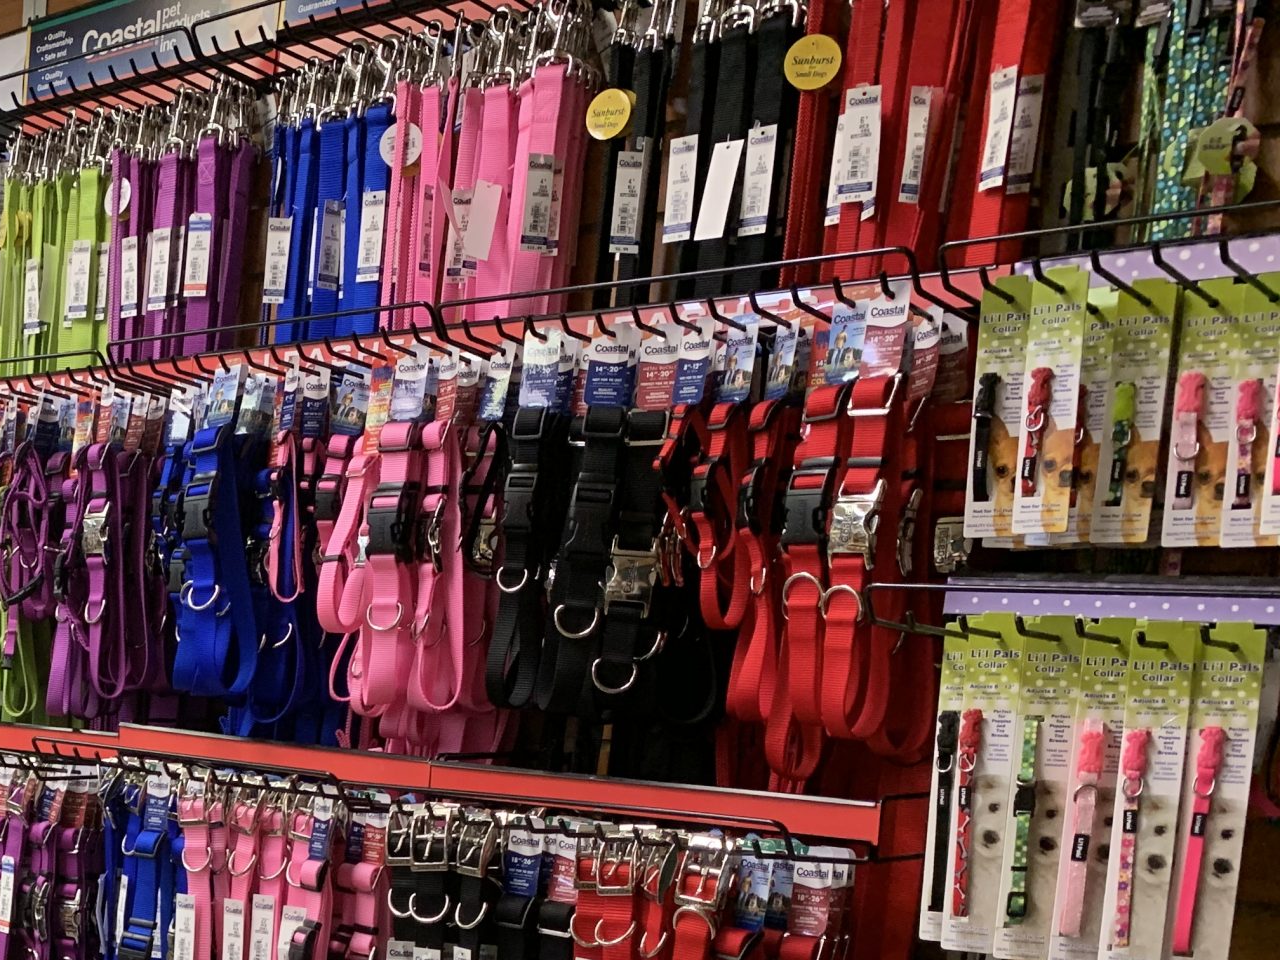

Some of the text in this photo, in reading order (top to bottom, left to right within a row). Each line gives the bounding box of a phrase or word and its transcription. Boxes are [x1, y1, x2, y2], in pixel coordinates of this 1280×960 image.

[48, 30, 66, 41] Quality
[81, 1, 182, 60] Coastal pet
[792, 55, 834, 66] Sunburst
[795, 69, 827, 80] Small Dogs
[849, 95, 879, 106] Coastal
[592, 107, 625, 117] Sunburst
[871, 304, 906, 317] Coastal
[1055, 302, 1082, 313] Pals
[834, 311, 866, 324] Coastal
[683, 340, 711, 351] Coastal
[727, 336, 753, 347] Coastal
[595, 343, 629, 353] Coastal
[645, 344, 679, 355] Coastal
[399, 363, 426, 372] Coastal
[490, 361, 512, 370] Coastal
[971, 650, 1020, 658] Li'l Pals
[1028, 653, 1080, 664] Li'l Pals
[1086, 658, 1105, 667] Li'l
[1133, 661, 1190, 671] Li'l Pals
[1203, 662, 1260, 672] Li'l Pals
[1035, 665, 1065, 673] Collar
[1142, 673, 1175, 682] Collar
[1211, 674, 1245, 683] Collar
[510, 835, 540, 846] Coastal
[742, 859, 769, 870] Coastal
[797, 867, 829, 878] Coastal
